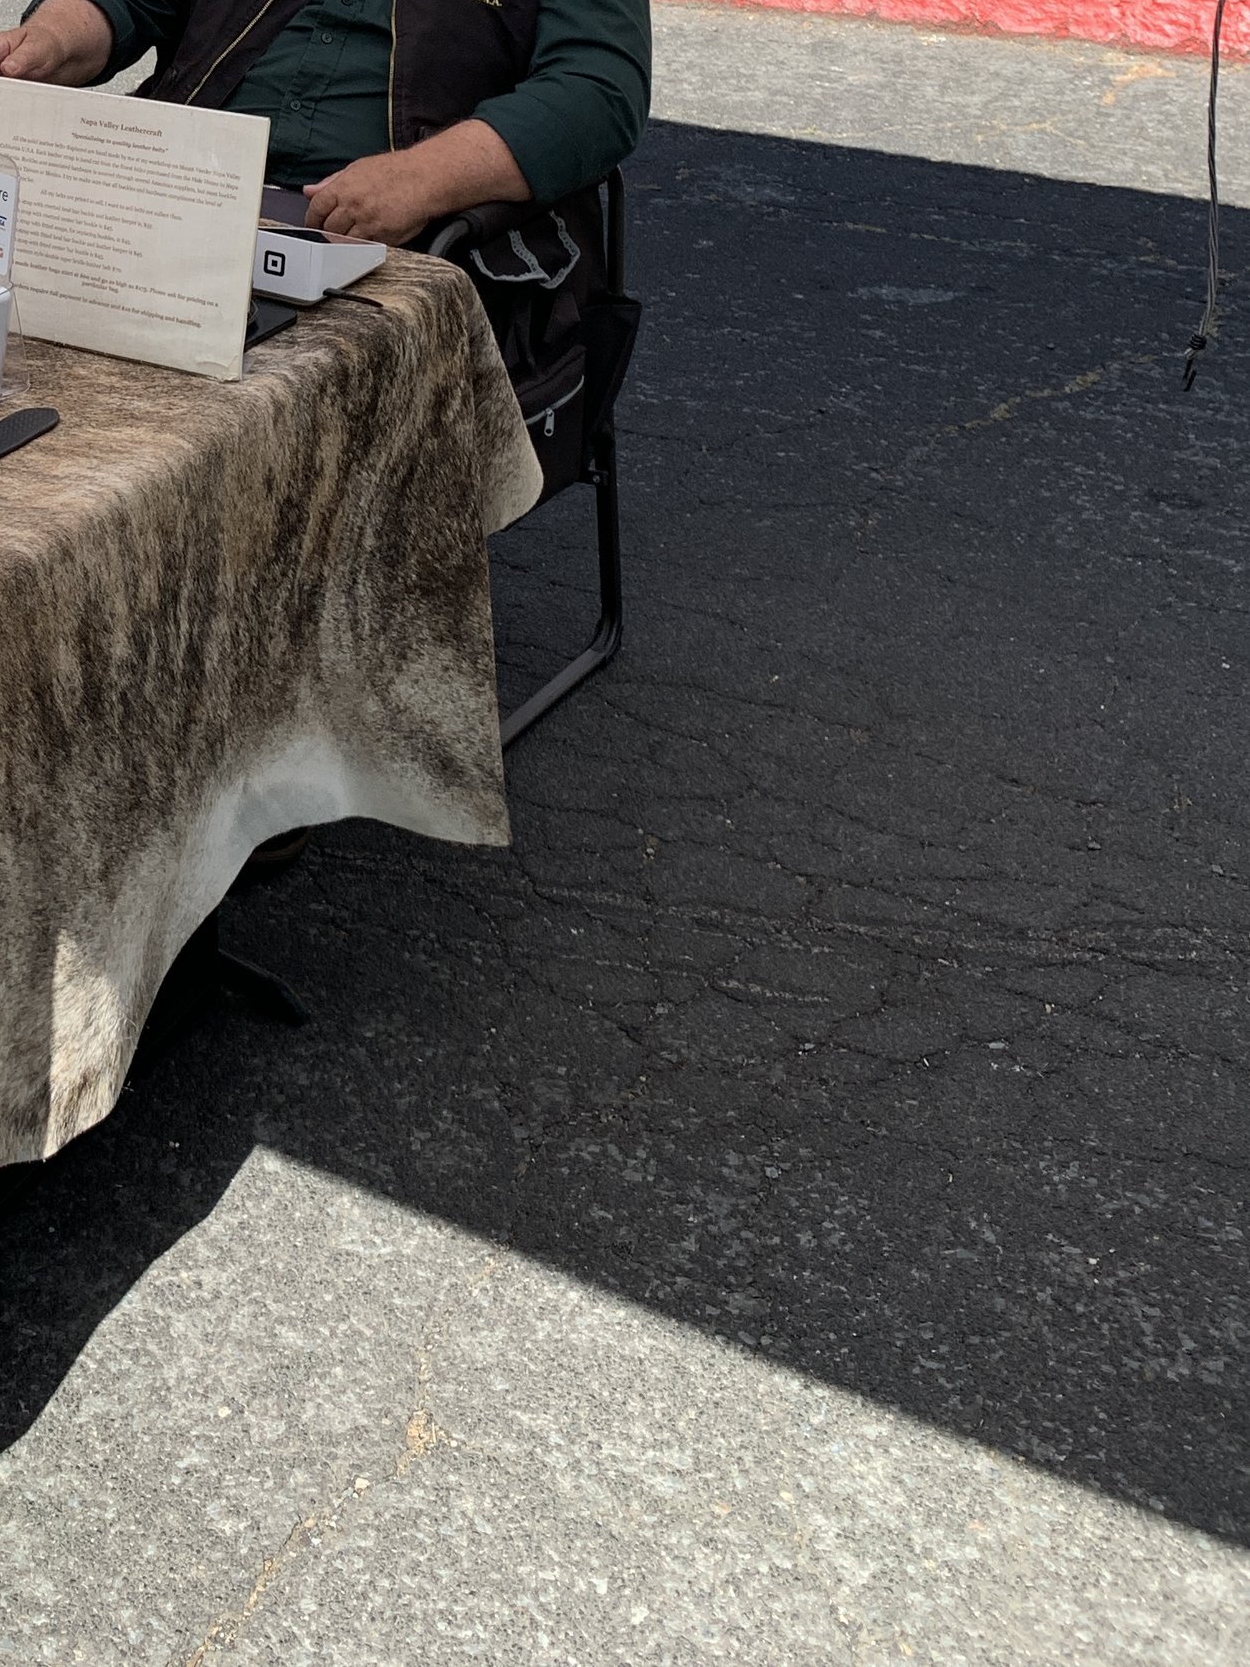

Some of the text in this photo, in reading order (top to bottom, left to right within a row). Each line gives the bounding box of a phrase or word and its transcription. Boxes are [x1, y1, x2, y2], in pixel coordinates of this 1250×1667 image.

[80, 117, 162, 137] Napa Valley Leathercraft
